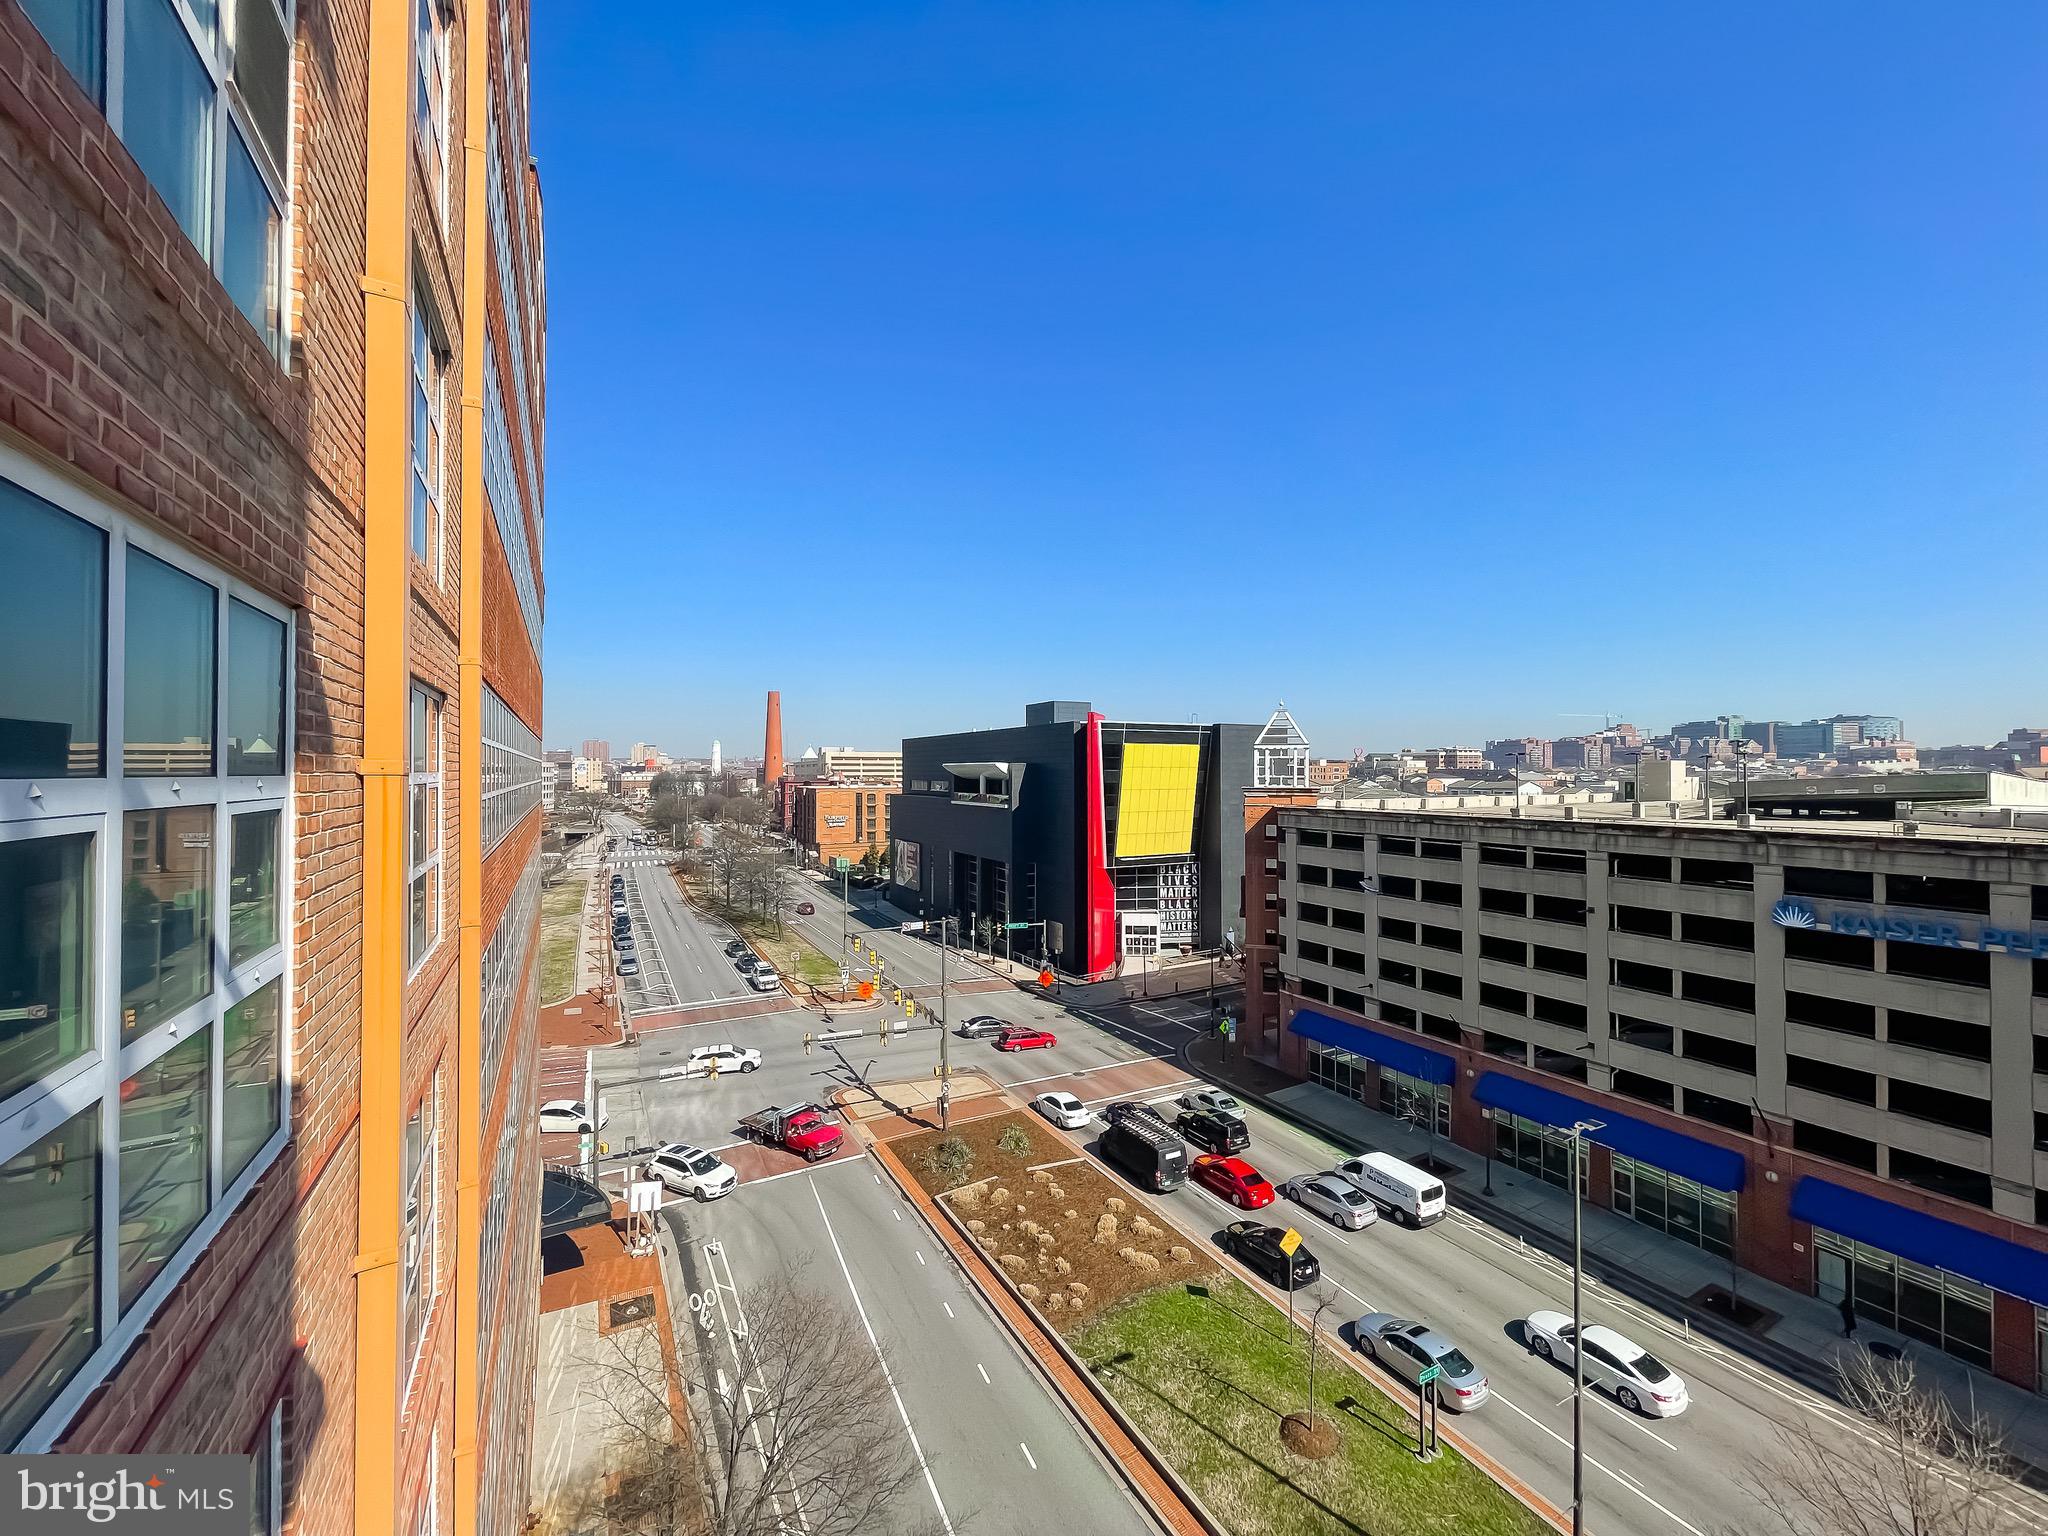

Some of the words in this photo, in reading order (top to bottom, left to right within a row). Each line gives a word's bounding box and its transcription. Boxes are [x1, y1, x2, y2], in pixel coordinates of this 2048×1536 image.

[1160, 864, 1198, 874] BLACK
[1160, 876, 1198, 885] LIVES
[1160, 888, 1198, 897] MATTER
[1160, 899, 1198, 909] BLACK
[1160, 911, 1198, 920] HISTORY
[1160, 922, 1198, 930] MATTERS
[1831, 911, 1962, 946] KAISER
